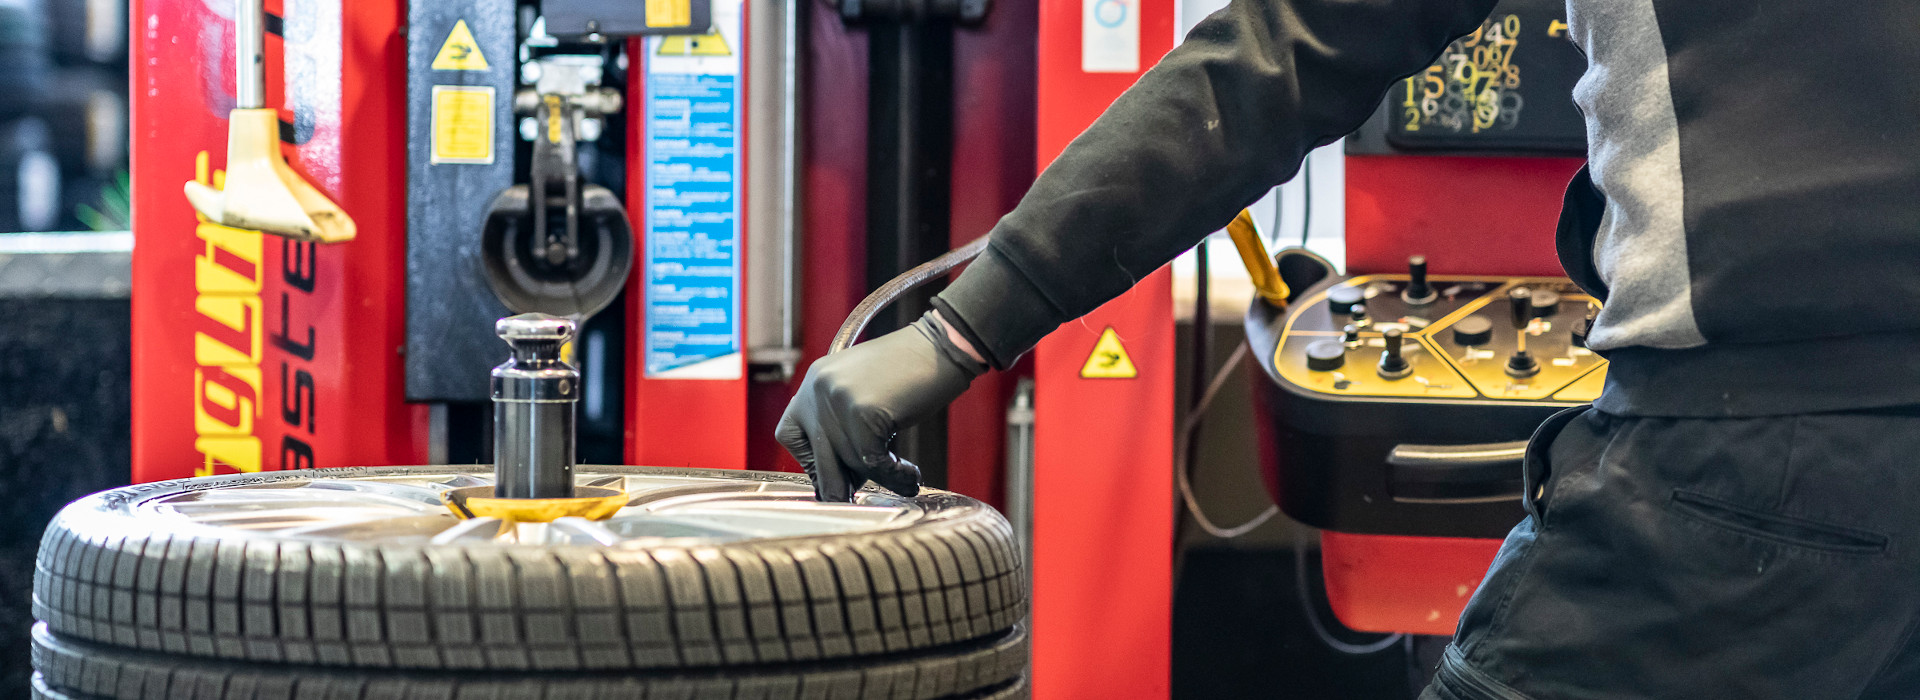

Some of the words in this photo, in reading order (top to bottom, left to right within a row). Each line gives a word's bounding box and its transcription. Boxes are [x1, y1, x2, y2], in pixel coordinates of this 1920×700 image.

[1505, 14, 1520, 38] 0
[1424, 65, 1445, 99] 5
[270, 238, 316, 470] aste
